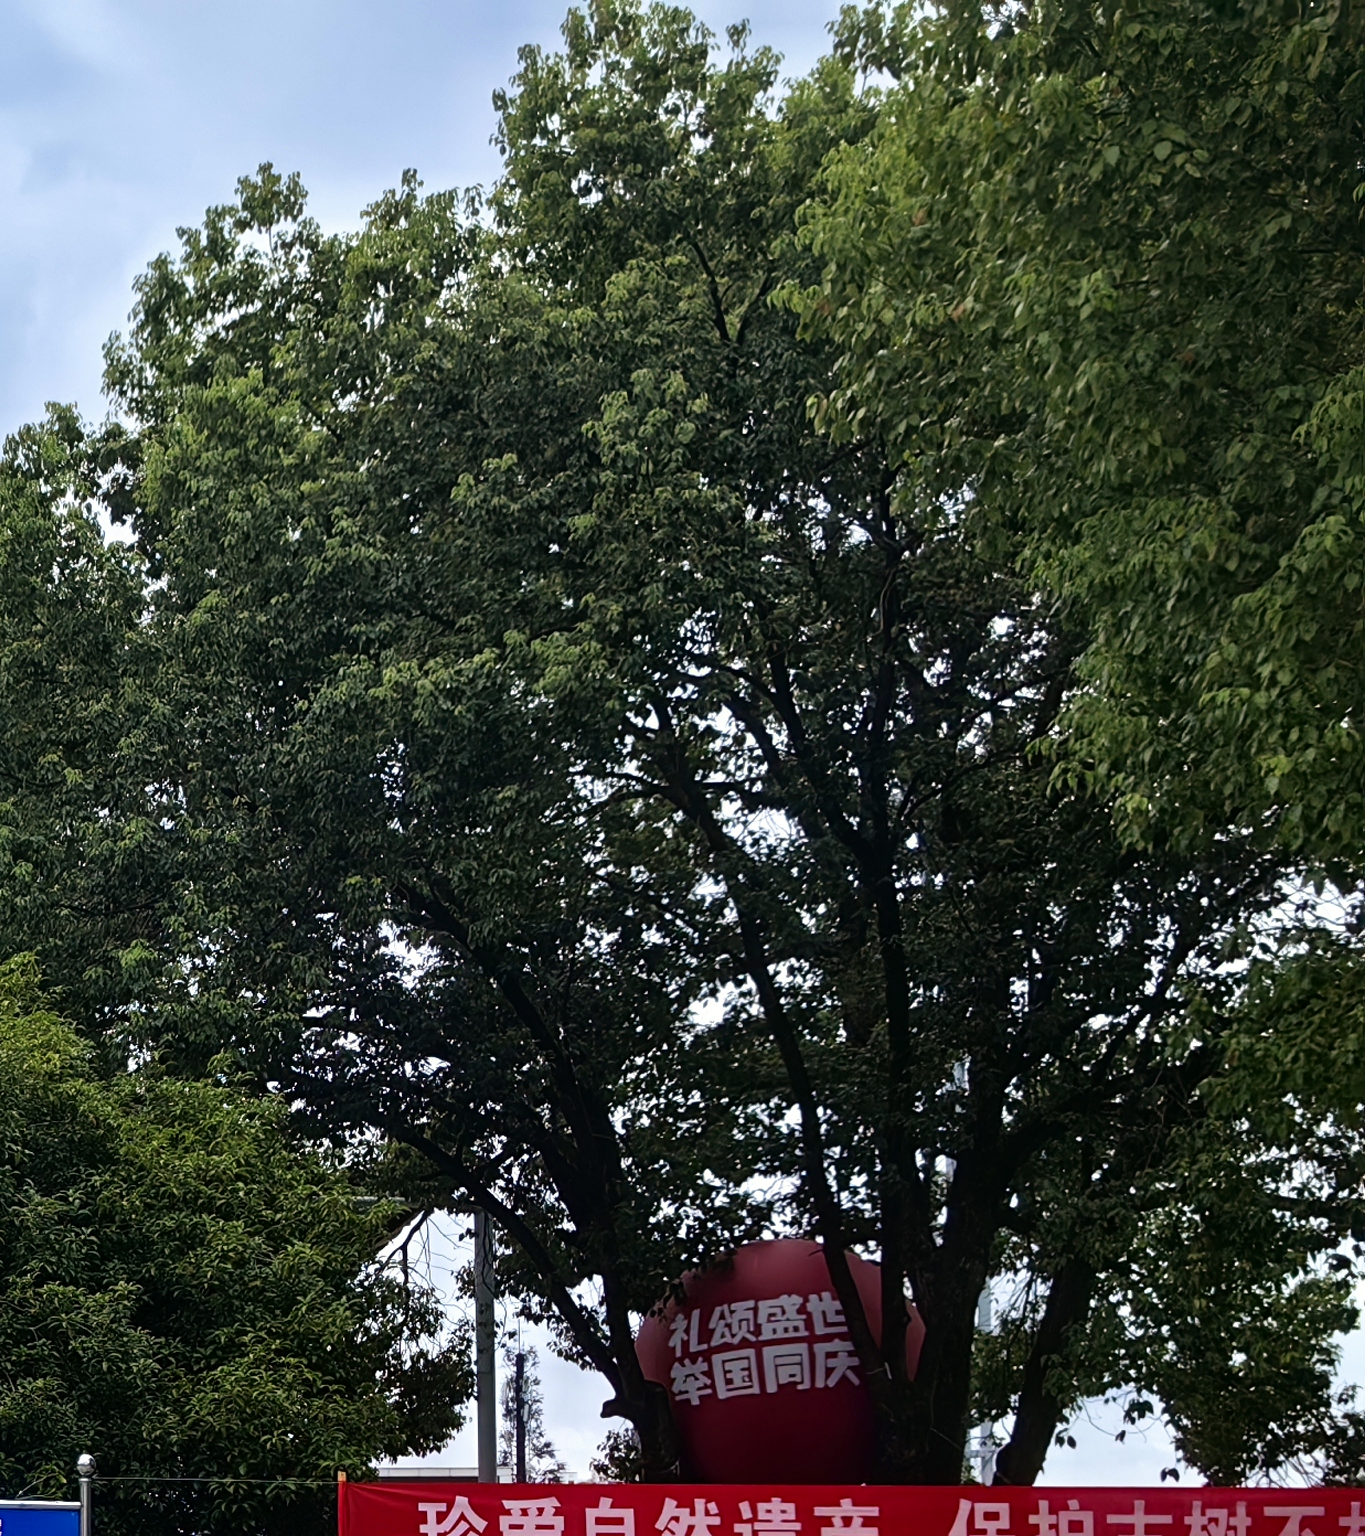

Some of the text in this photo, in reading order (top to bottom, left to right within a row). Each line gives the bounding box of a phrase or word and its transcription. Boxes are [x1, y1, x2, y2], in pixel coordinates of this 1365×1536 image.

[668, 1291, 849, 1358] 礼颂盛世
[669, 1338, 861, 1406] 举国同庆
